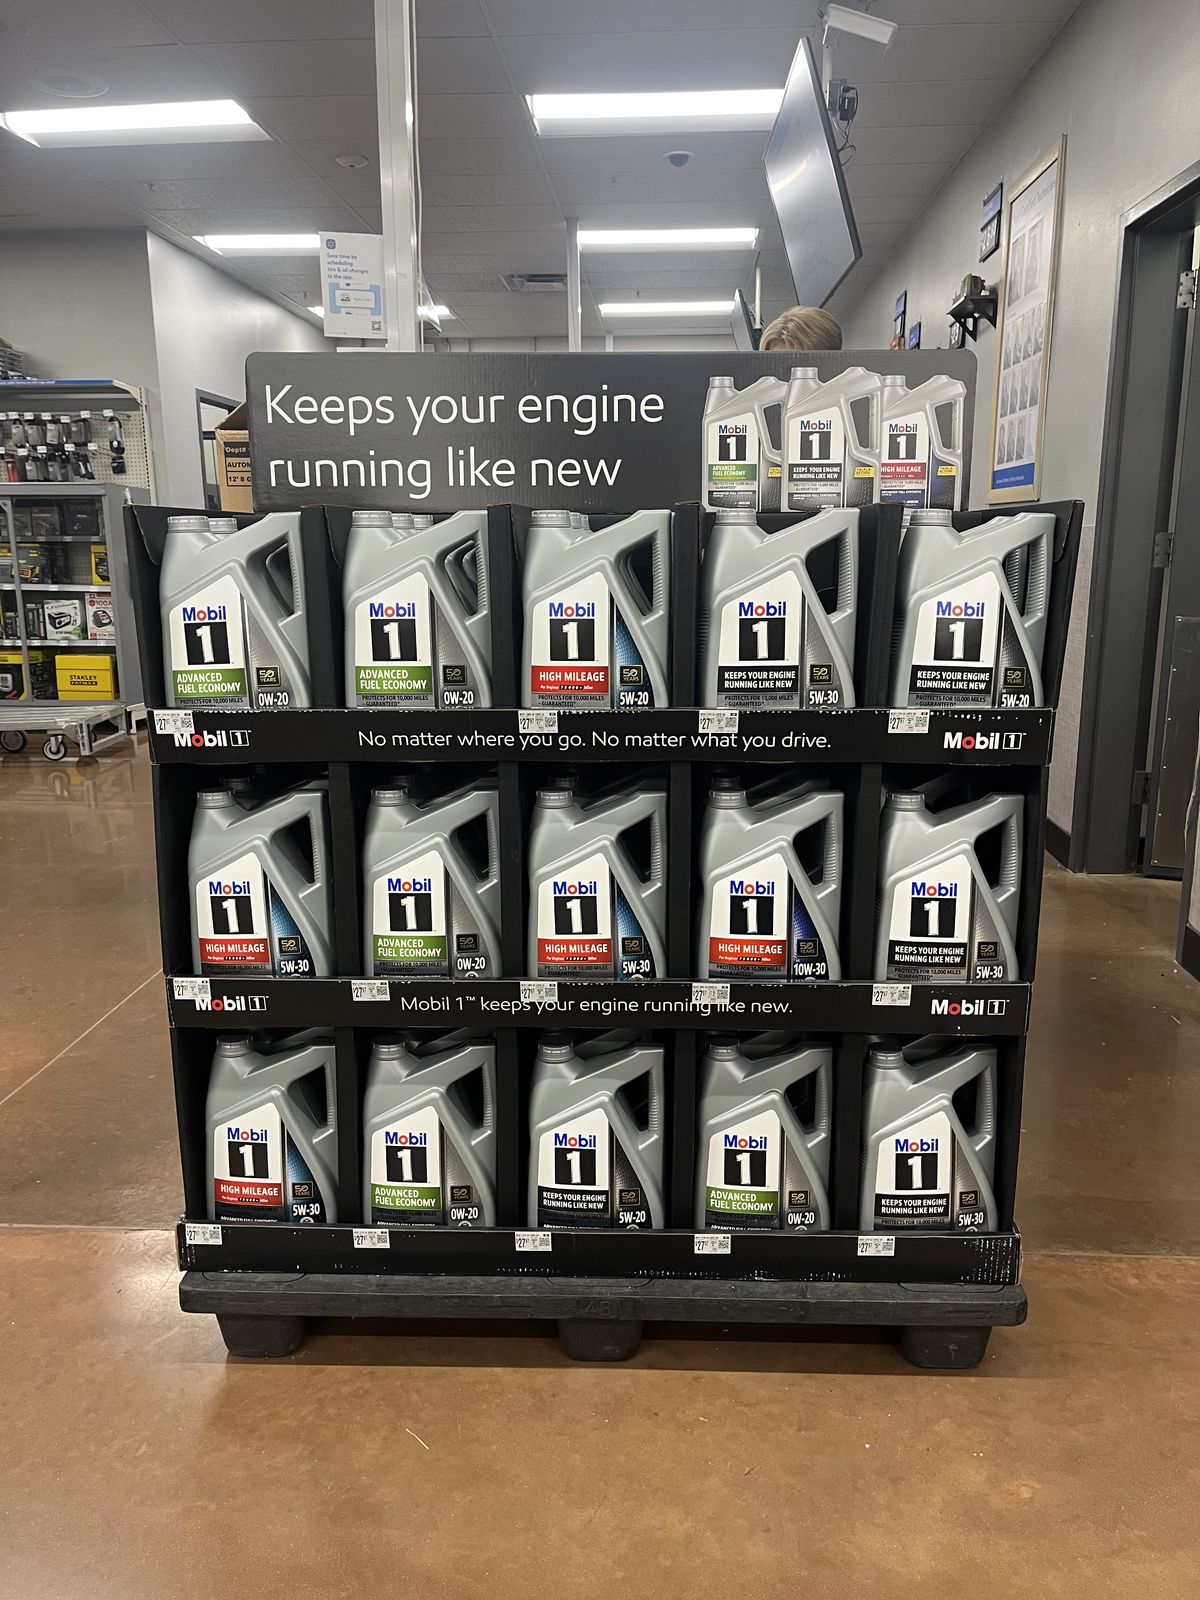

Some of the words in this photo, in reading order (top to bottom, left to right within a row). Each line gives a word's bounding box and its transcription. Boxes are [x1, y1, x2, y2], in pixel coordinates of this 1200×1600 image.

[266, 384, 394, 435] Keeps
[407, 393, 504, 435] your
[517, 384, 664, 435] engine
[719, 425, 746, 433] Mobil
[801, 420, 831, 430] Mobil
[889, 424, 917, 432] Mobil
[270, 450, 431, 499] running
[448, 446, 515, 487] like
[531, 458, 622, 486] new
[183, 606, 226, 621] Mobil
[370, 603, 415, 617] Mobil
[549, 603, 595, 617] Mobil
[739, 602, 786, 616] Mobil
[936, 602, 984, 617] Mobil
[177, 673, 222, 682] ADVANCED
[540, 672, 562, 681] HIGH
[564, 672, 604, 681] MILEAGE
[918, 671, 940, 679] KEEPS
[942, 672, 962, 680] YOUR
[963, 672, 990, 681] ENGINE
[178, 684, 196, 693] FUEL
[199, 683, 240, 693] ECONOMY
[725, 680, 758, 688] RUNNING
[917, 680, 951, 688] RUNNING
[952, 681, 968, 689] LIKE
[259, 693, 288, 706] 0W-20
[444, 691, 474, 704] 0W-20
[620, 692, 649, 705] 5W-20
[809, 691, 838, 704] 5W-30
[1001, 694, 1030, 708] 5W-20
[174, 730, 227, 747] Mobil
[358, 731, 386, 746] No
[392, 732, 452, 746] matter
[457, 730, 515, 746] where
[519, 735, 552, 750] you
[558, 735, 586, 750] go.
[592, 731, 619, 747] No
[625, 732, 686, 747] matter
[691, 733, 737, 747] what
[742, 735, 776, 751] you
[781, 731, 831, 748] drive.
[944, 732, 1000, 749] Mobil
[209, 881, 250, 895] Mobil
[388, 878, 431, 891] Mobil
[554, 882, 596, 894] Mobil
[730, 881, 774, 895] Mobil
[912, 882, 958, 896] Mobil
[206, 944, 226, 952] HIGH
[228, 944, 264, 952] MILEAGE
[378, 938, 423, 947] ADVANCED
[545, 944, 566, 952] HIGH
[570, 944, 608, 952] MILEAGE
[718, 943, 740, 953] HIGH
[743, 944, 782, 954] MILEAGE
[378, 948, 397, 956] FUEL
[400, 948, 441, 957] ECONOMY
[281, 960, 309, 973] 5W-30
[457, 957, 485, 970] 0W-20
[623, 960, 650, 973] 5W-30
[794, 963, 826, 975] 10W-30
[976, 966, 1003, 978] 5W-30
[196, 996, 246, 1011] Mobil
[401, 996, 450, 1011] Mobil
[481, 997, 531, 1014] keeps
[536, 1000, 575, 1014] your
[580, 998, 638, 1015] engine
[644, 999, 711, 1016] running
[717, 1002, 746, 1013] like
[752, 1002, 793, 1013] new.
[931, 1000, 984, 1015] Mobil
[228, 1127, 267, 1142] Mobil
[385, 1132, 426, 1145] Mobil
[554, 1133, 596, 1148] Mobil
[724, 1135, 767, 1149] Mobil
[895, 1139, 938, 1152] Mobil
[710, 1190, 756, 1201] ADVANCED
[293, 1204, 320, 1216] 5W-30
[710, 1199, 730, 1209] FUEL
[732, 1202, 773, 1211] ECONOMY
[451, 1208, 478, 1220] 0W-20
[619, 1211, 646, 1224] 5W-20
[788, 1212, 815, 1224] 0W-20
[958, 1212, 984, 1226] 5W-30
